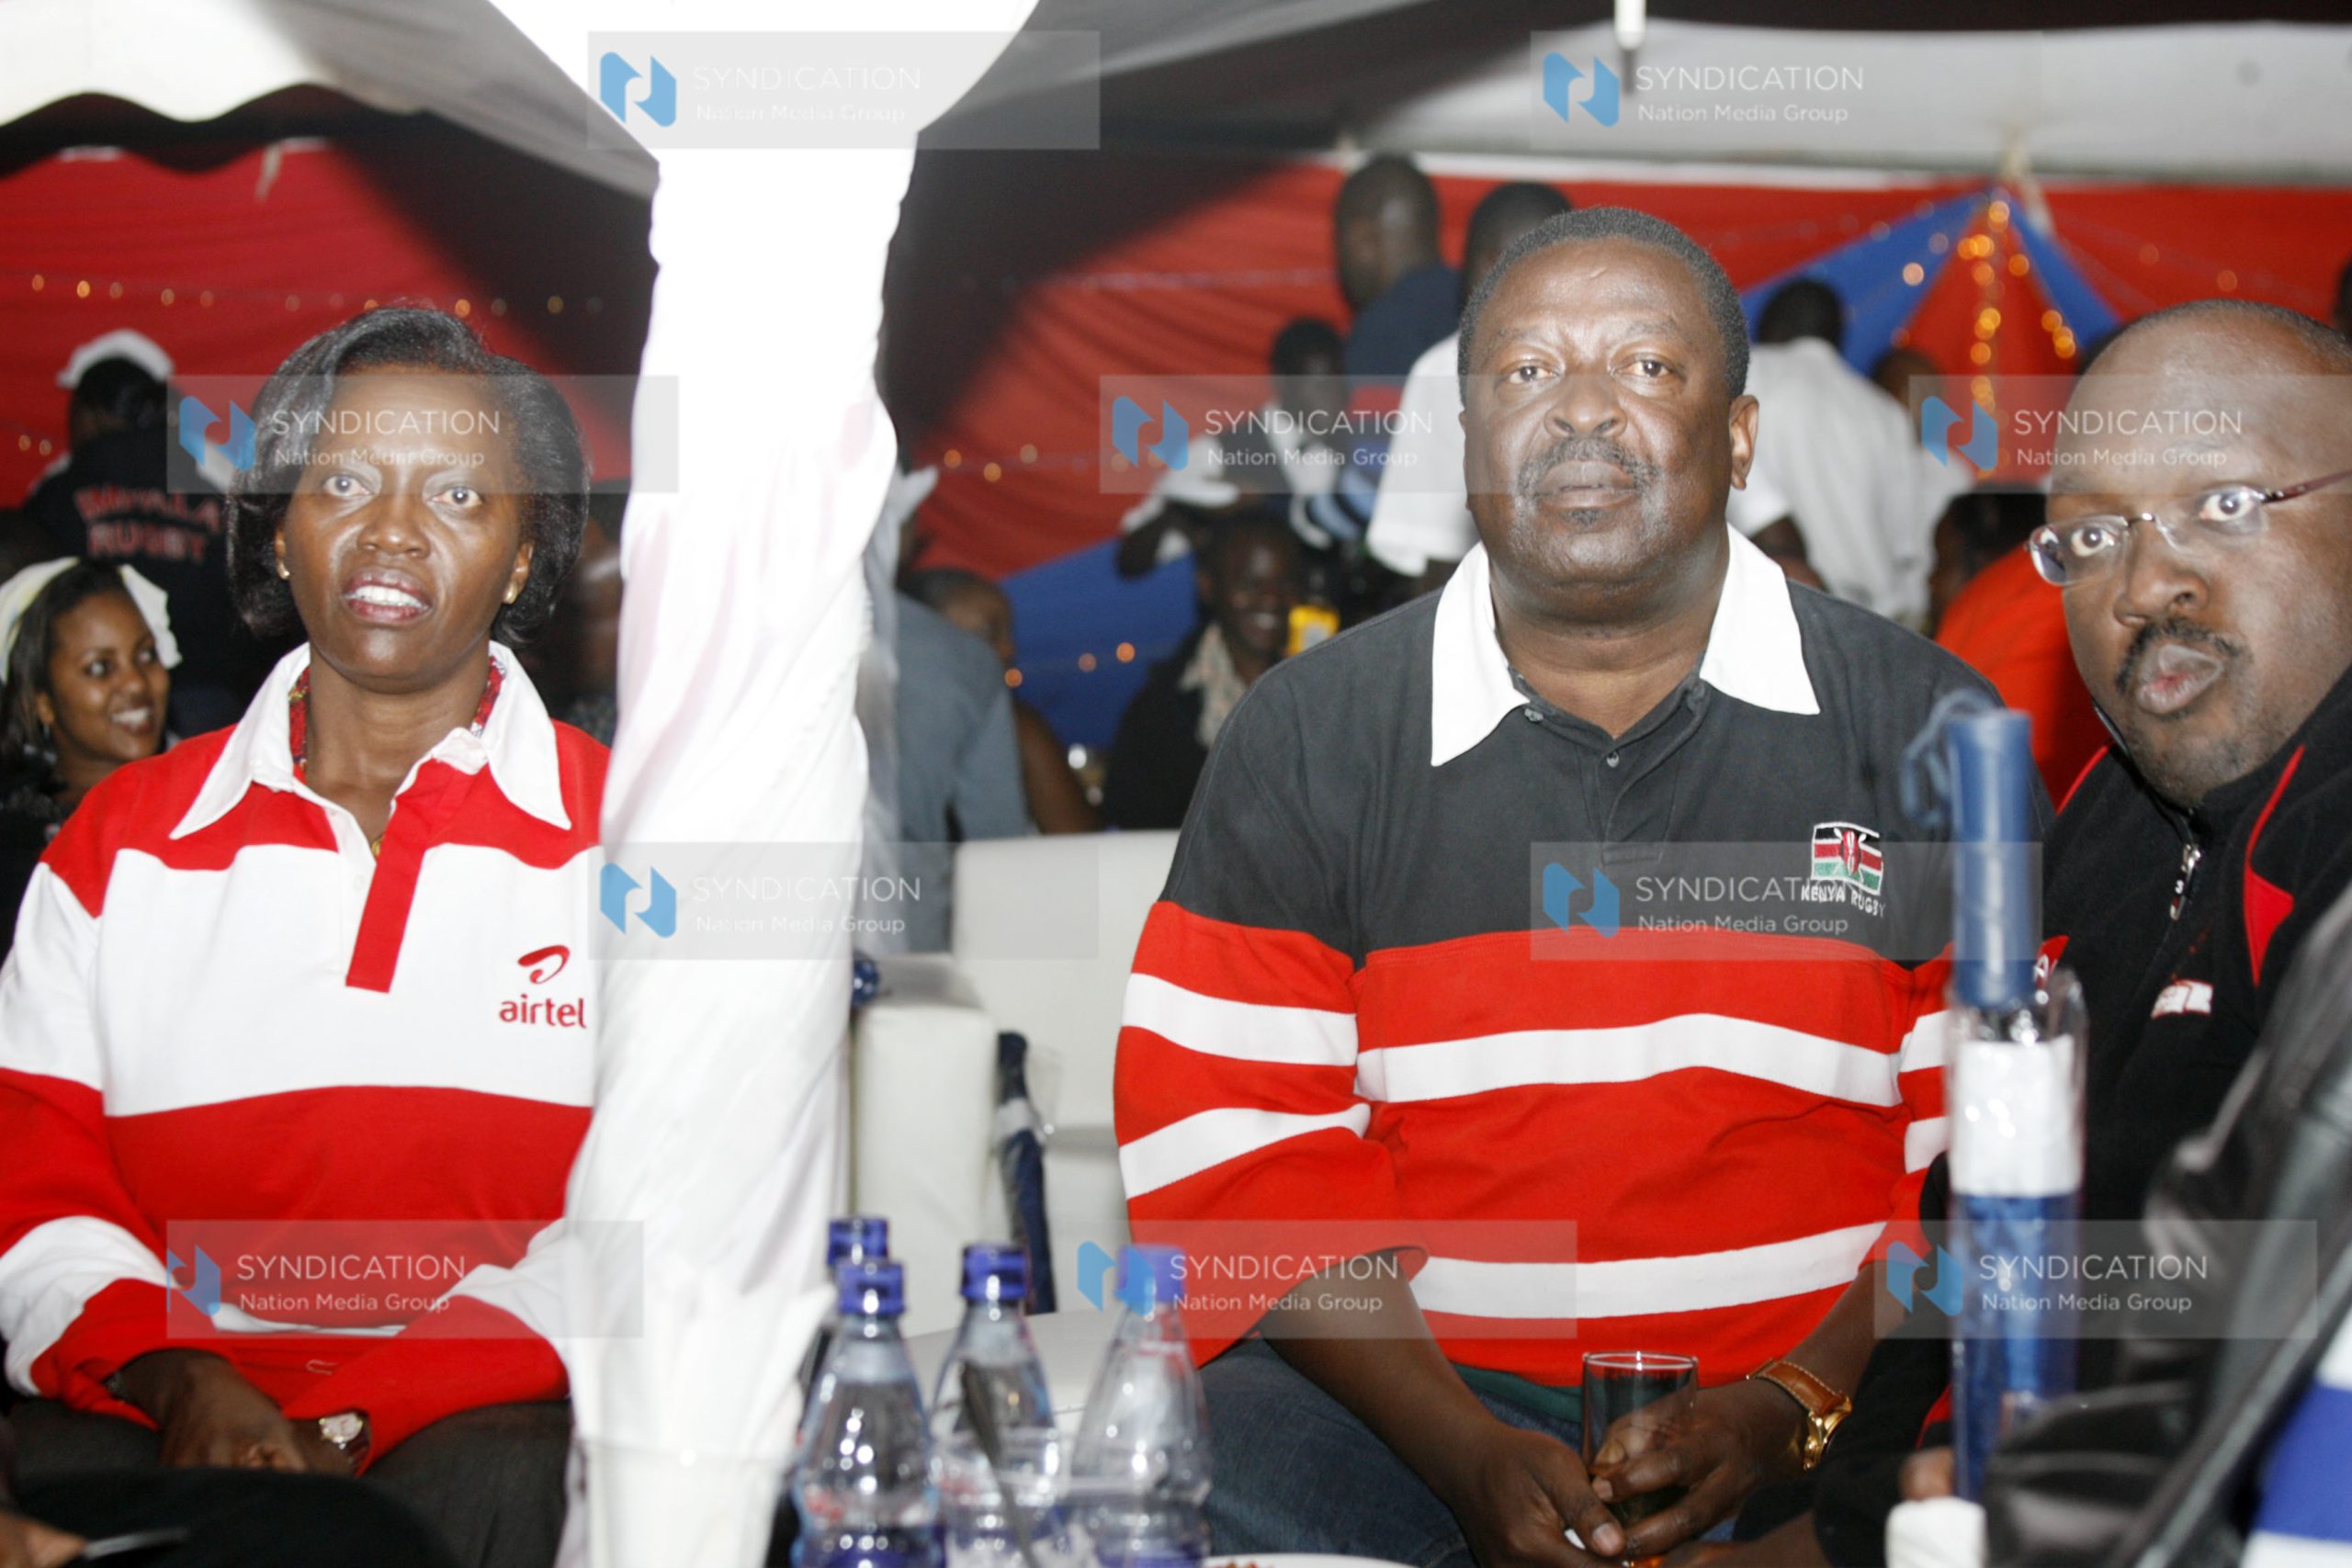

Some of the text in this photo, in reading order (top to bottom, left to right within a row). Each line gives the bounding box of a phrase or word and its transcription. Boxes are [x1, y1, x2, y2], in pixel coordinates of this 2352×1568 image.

[1801, 883, 1885, 918] KENYA RUGBY
[499, 993, 587, 1029] airtel
